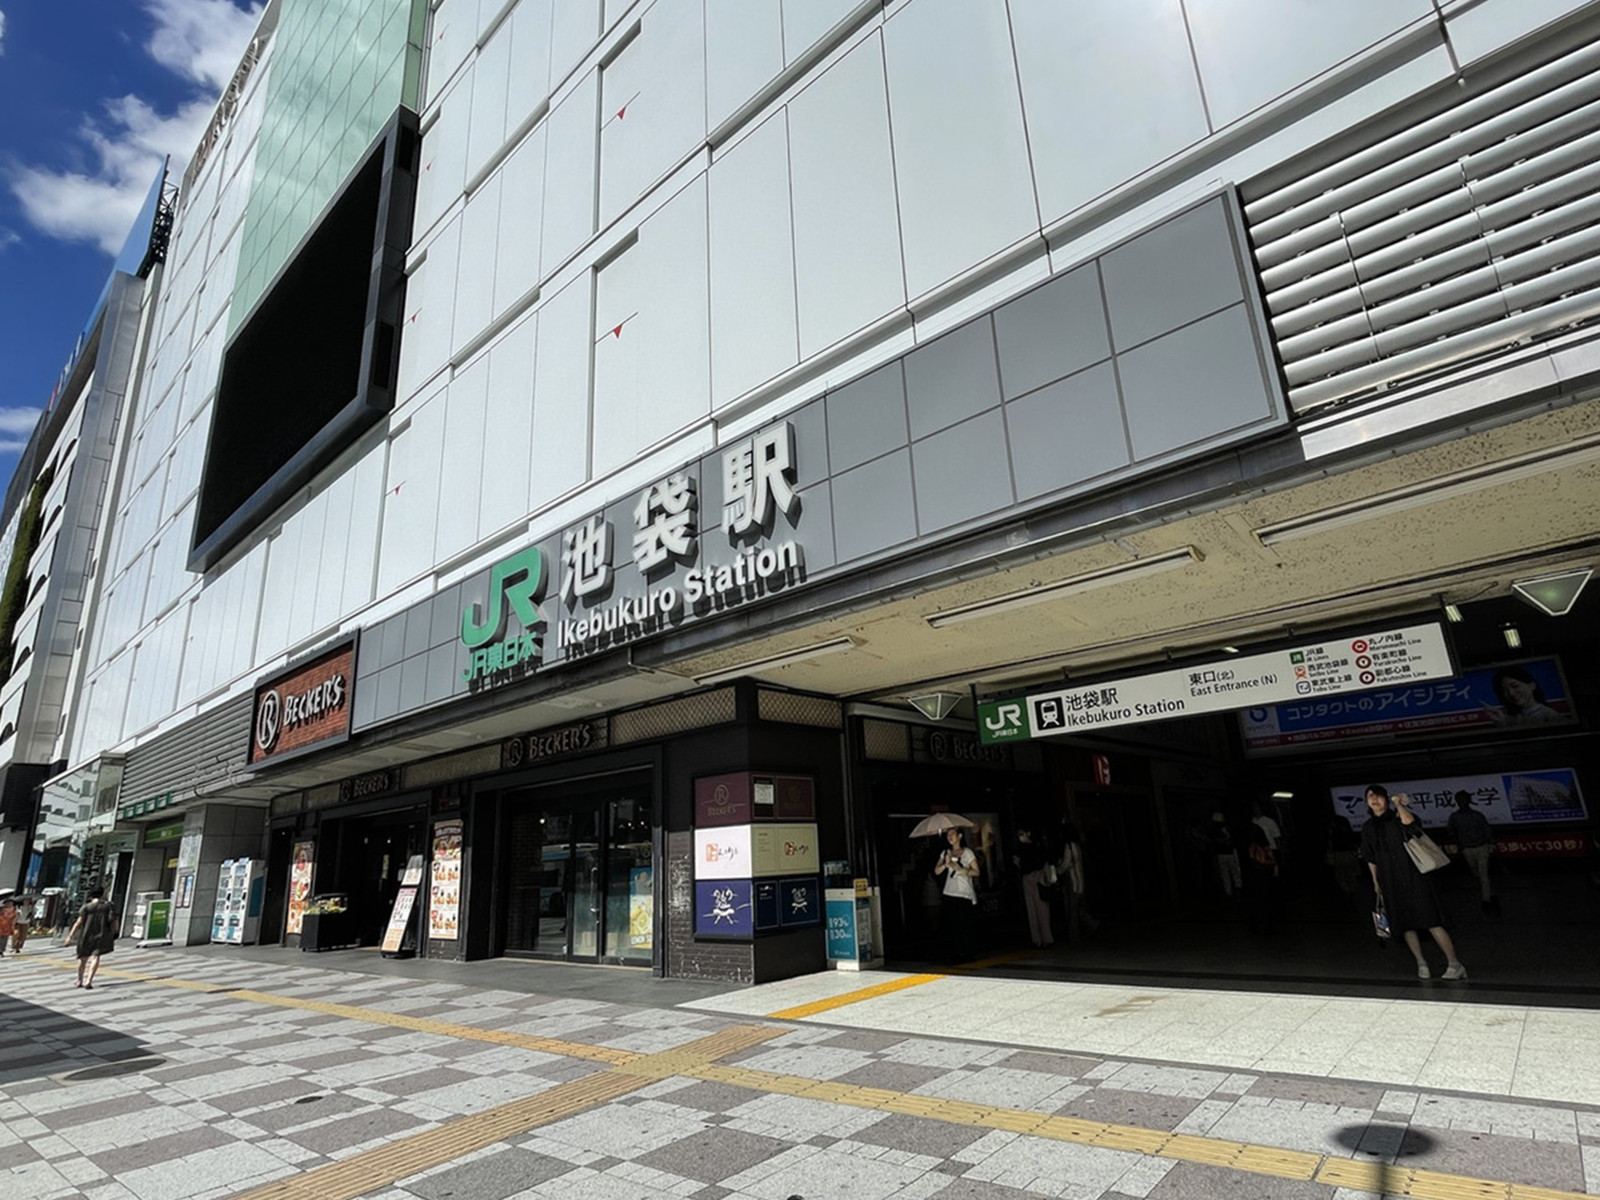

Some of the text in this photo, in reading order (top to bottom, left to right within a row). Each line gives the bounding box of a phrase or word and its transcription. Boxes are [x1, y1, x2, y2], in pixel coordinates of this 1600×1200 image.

[560, 421, 802, 606] 池袋駅
[461, 547, 546, 648] JR
[558, 541, 798, 649] Ikebukuro Station
[1306, 647, 1324, 656] JR線
[1368, 633, 1403, 645] 丸ノ内線
[1369, 641, 1407, 651] Marunouchi
[461, 632, 540, 682] JR東日本
[1372, 649, 1407, 661] 有楽町線
[1188, 669, 1235, 686] 東口(北)
[1190, 674, 1278, 697] East Entrance (N)
[283, 674, 346, 727] BECKER'S
[1065, 687, 1119, 712] 池袋駅
[1067, 698, 1185, 727] Ikebukuro Station
[1286, 683, 1471, 721] コンタクトのアイシティ
[985, 703, 1022, 731] JR
[529, 723, 590, 759] BECKER'S
